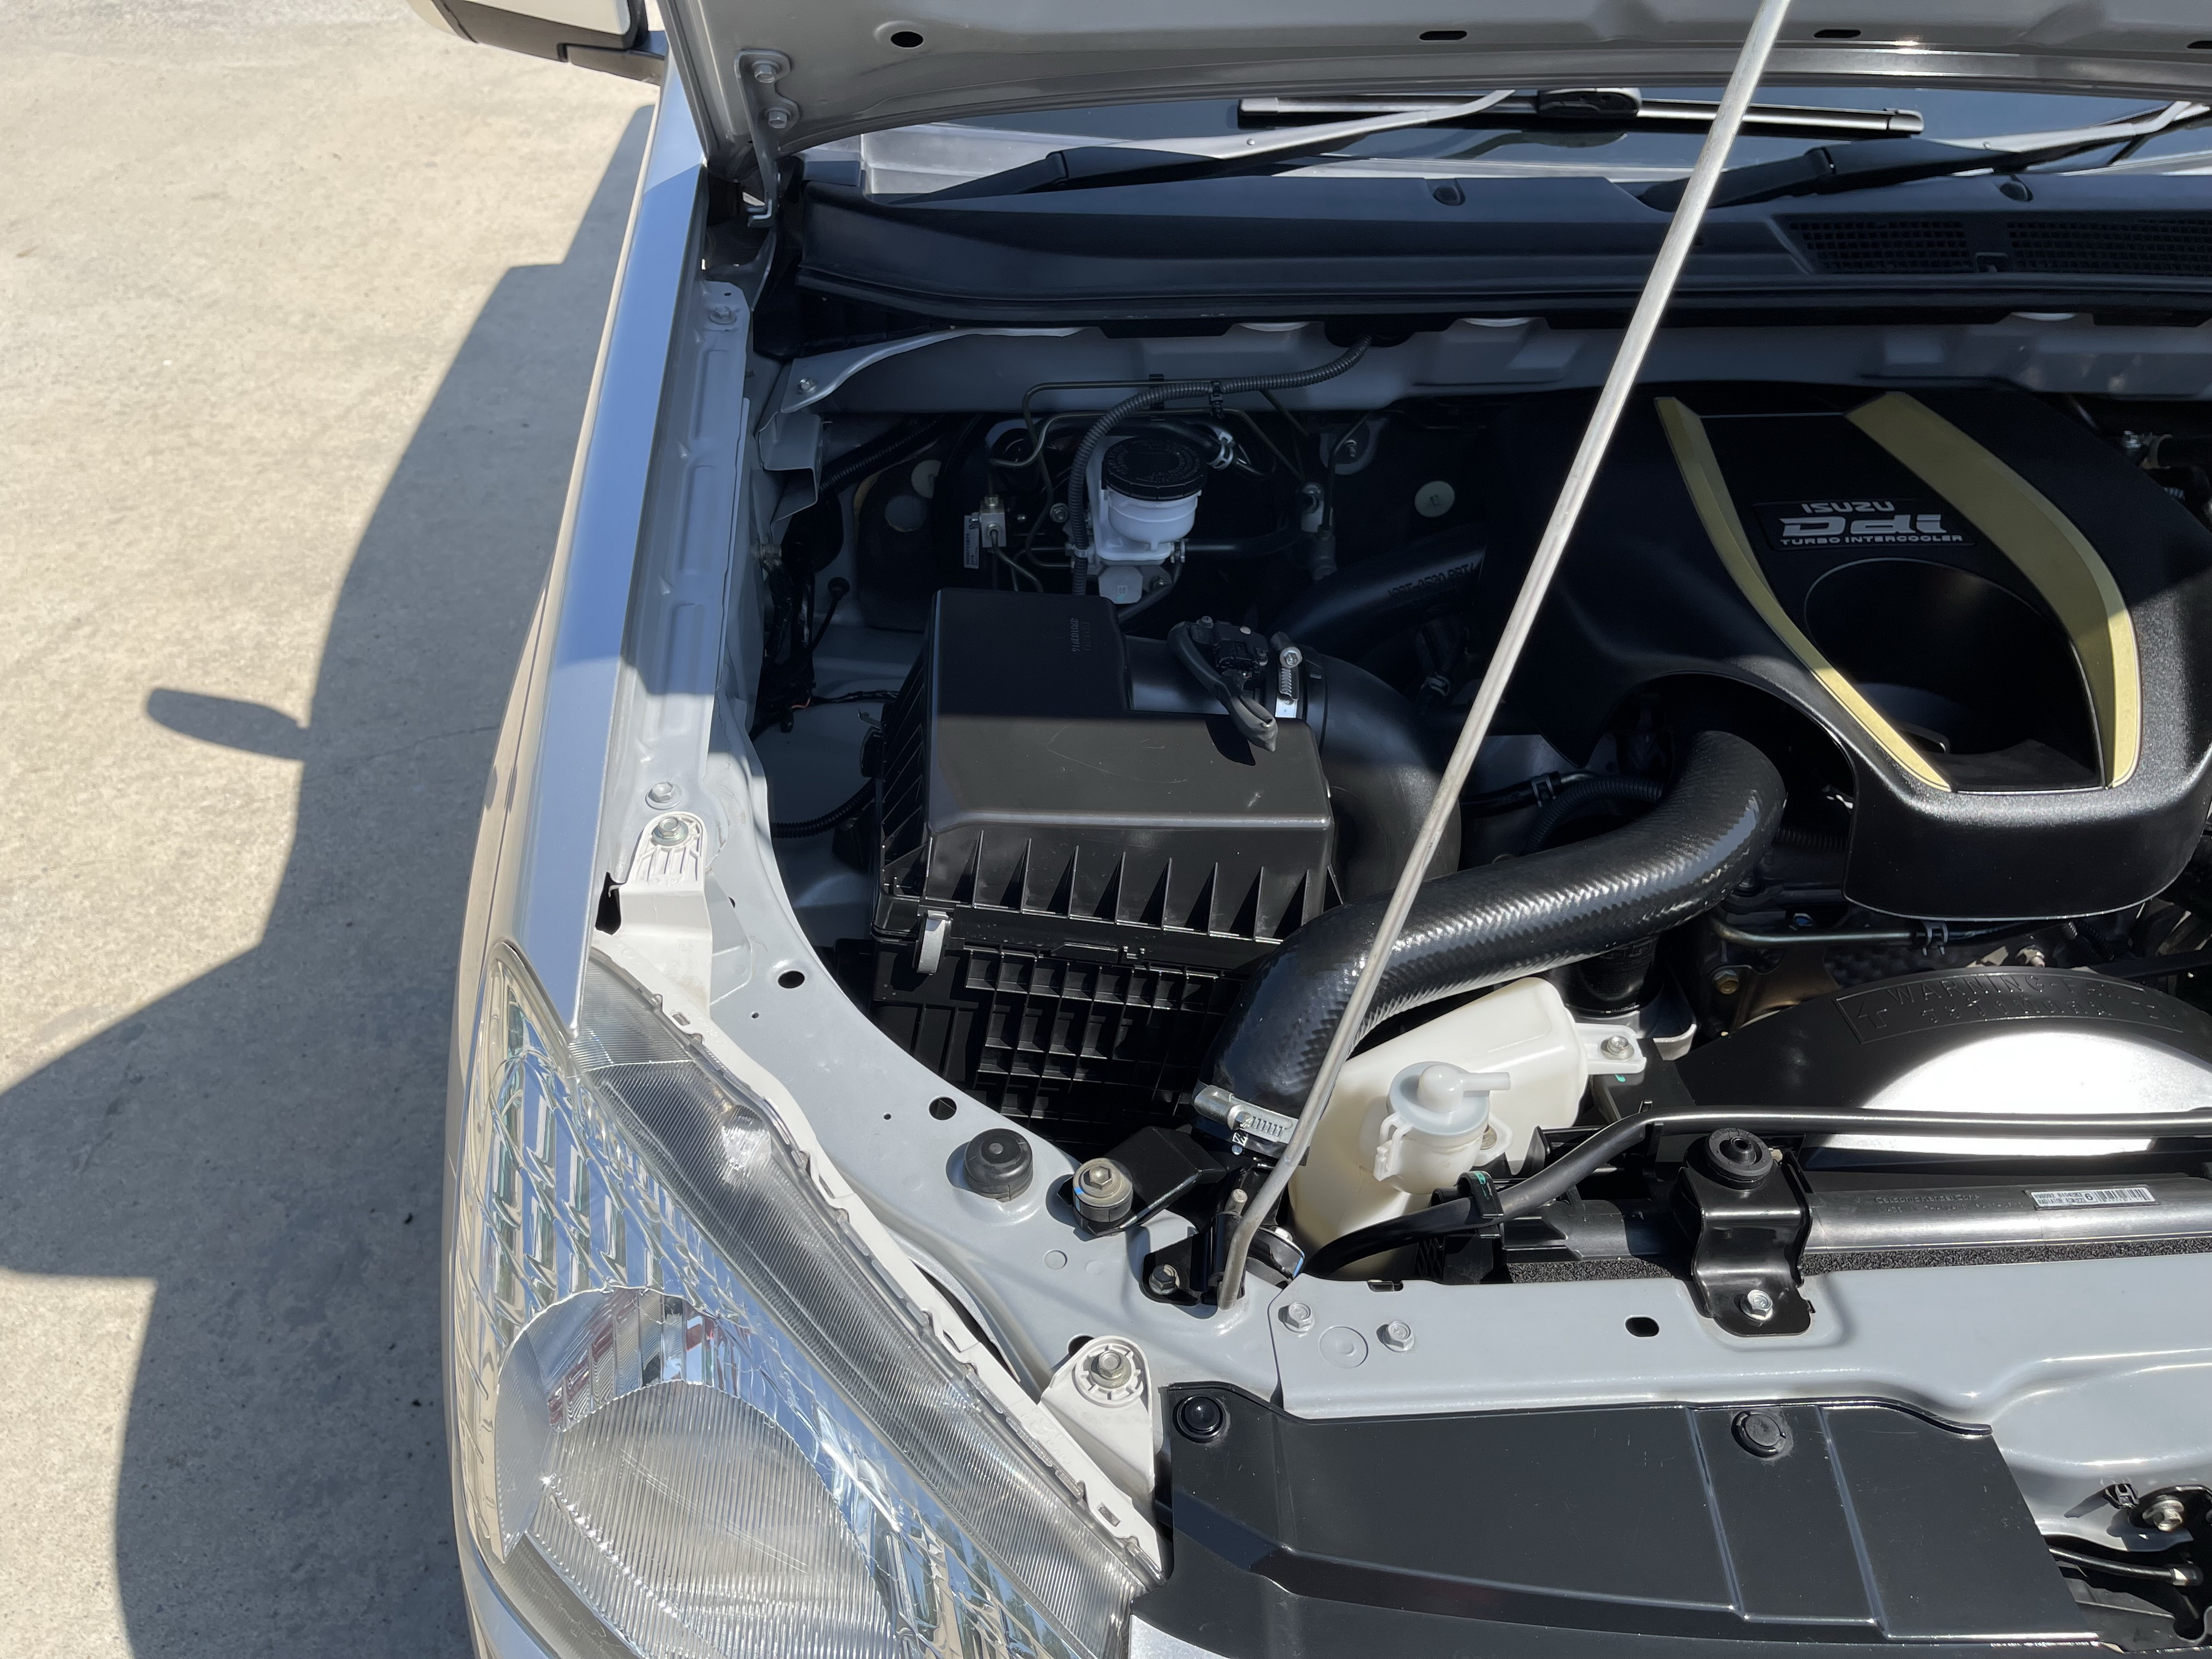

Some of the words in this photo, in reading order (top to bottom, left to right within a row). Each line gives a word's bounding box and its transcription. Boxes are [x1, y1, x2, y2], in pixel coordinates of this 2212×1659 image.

[1801, 501, 1895, 514] ISUZU
[1780, 537, 1840, 545] TURBO
[1845, 535, 1963, 544] INTERCOOLER
